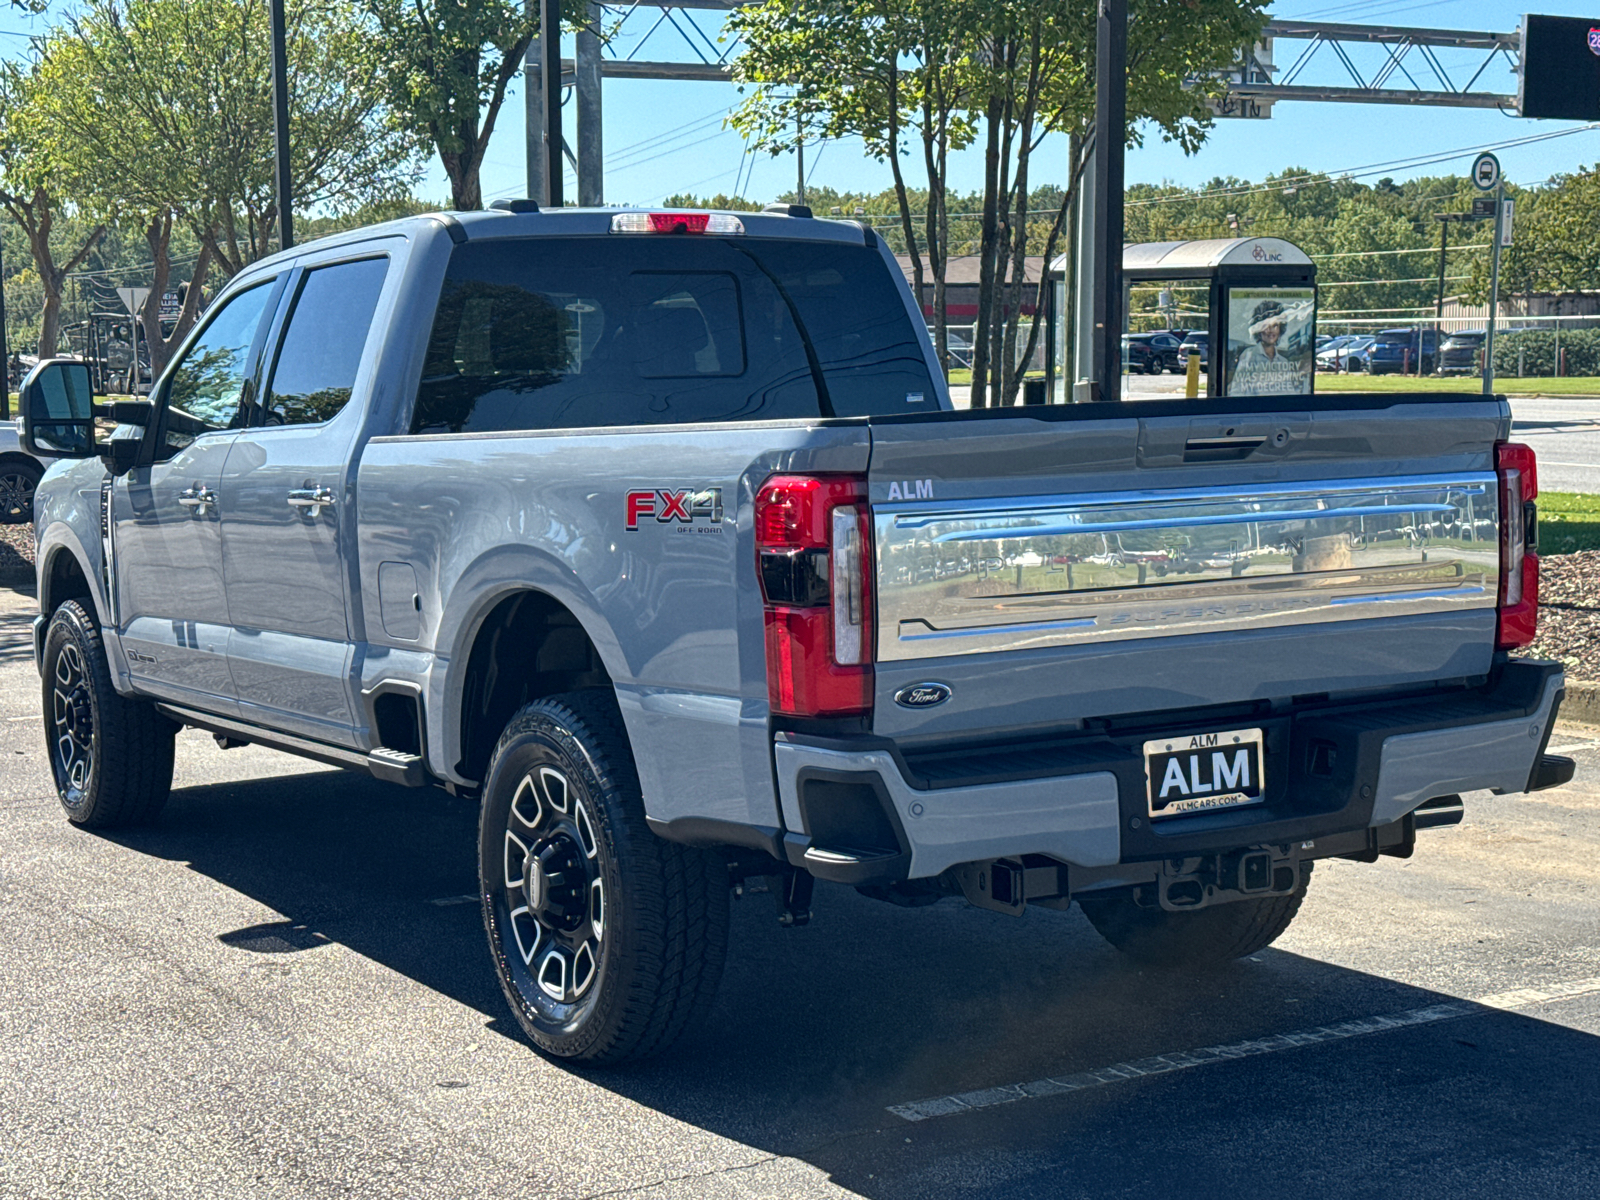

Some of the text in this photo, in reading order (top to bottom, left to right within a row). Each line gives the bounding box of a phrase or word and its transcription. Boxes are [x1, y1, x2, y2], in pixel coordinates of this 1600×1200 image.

[1264, 253, 1282, 261] LINC
[1261, 362, 1300, 371] VICTORY
[1235, 371, 1304, 381] WAS FINISHING
[1241, 383, 1255, 392] MY
[888, 479, 934, 500] ALM
[625, 488, 723, 531] FX4
[1110, 606, 1226, 624] SUPER
[909, 689, 940, 702] Ford
[1190, 734, 1218, 748] ALM
[1159, 749, 1250, 797] ALM
[1176, 796, 1238, 811] ALMCARS.COM
